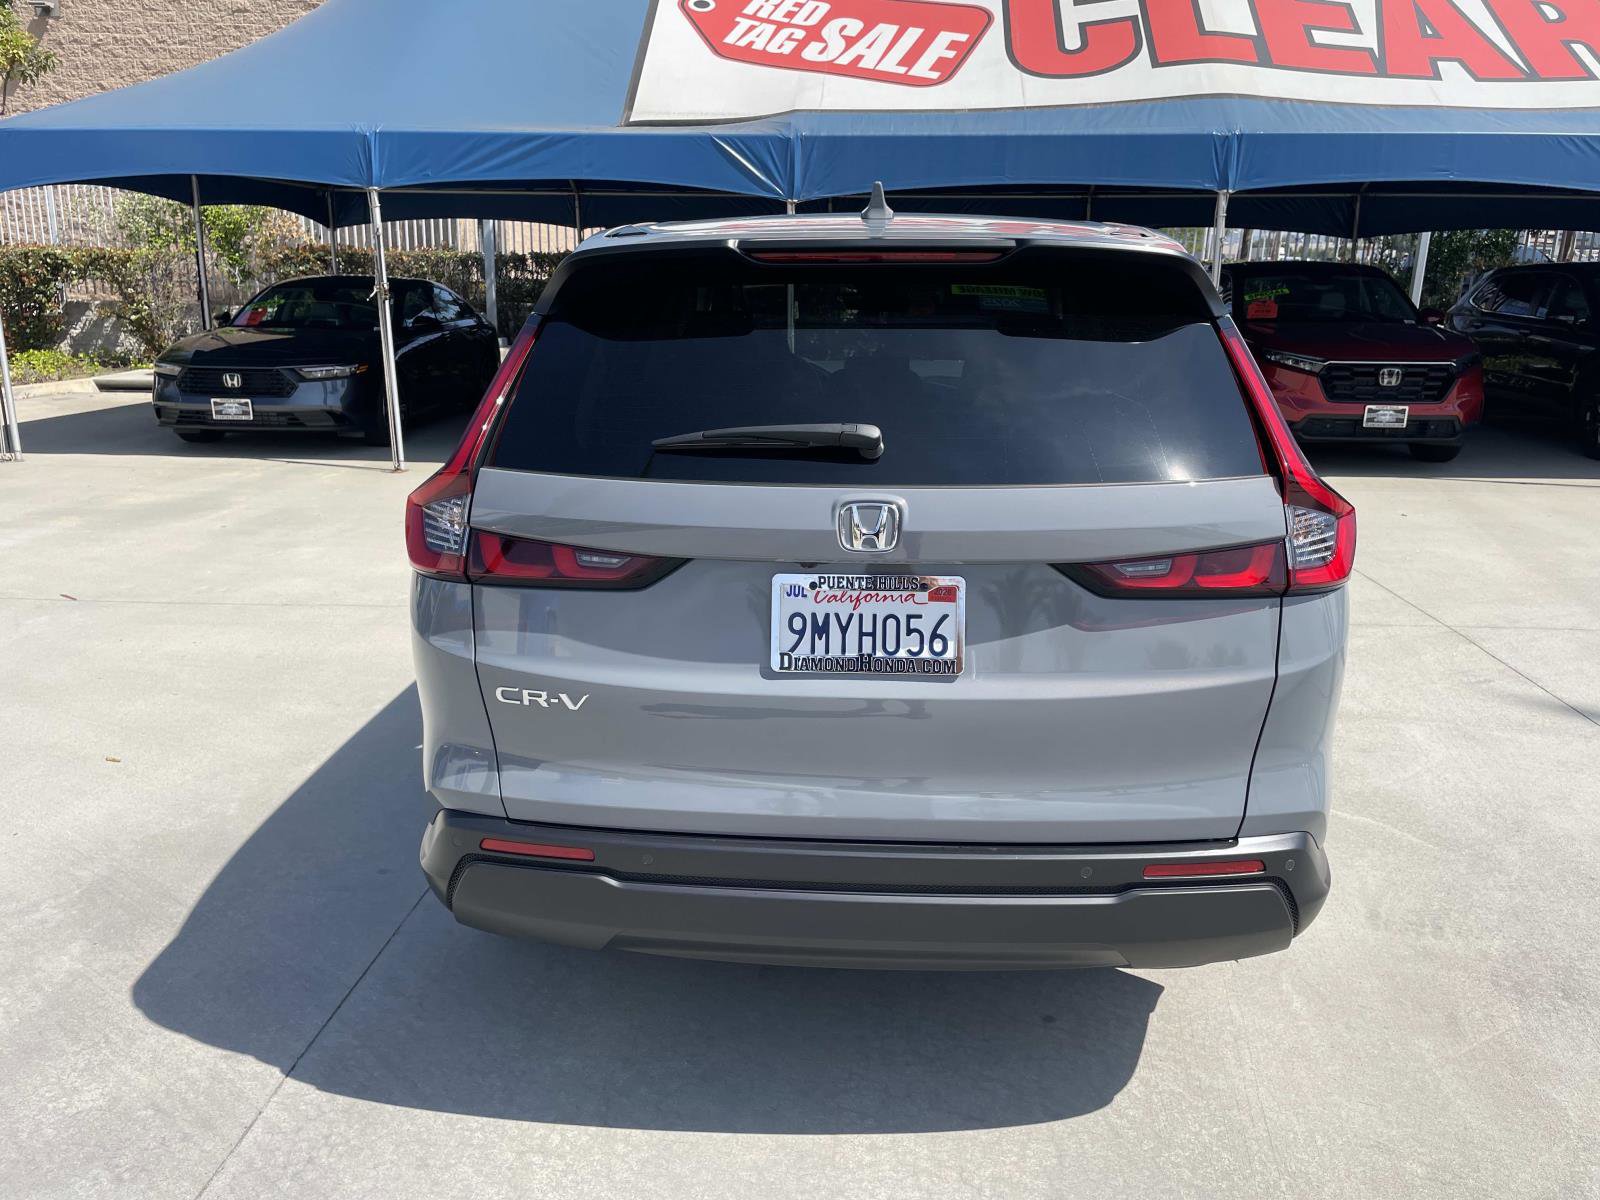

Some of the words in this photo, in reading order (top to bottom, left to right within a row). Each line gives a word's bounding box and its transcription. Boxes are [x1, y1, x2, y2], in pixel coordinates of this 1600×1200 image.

[741, 0, 831, 27] RED
[722, 16, 806, 55] TAG
[801, 17, 970, 80] SALE
[786, 584, 808, 598] JUL
[818, 576, 874, 590] PUENTE
[876, 576, 920, 590] HILLS
[814, 590, 928, 611] California
[787, 611, 950, 657] 9MYH056
[495, 686, 590, 711] CR-V
